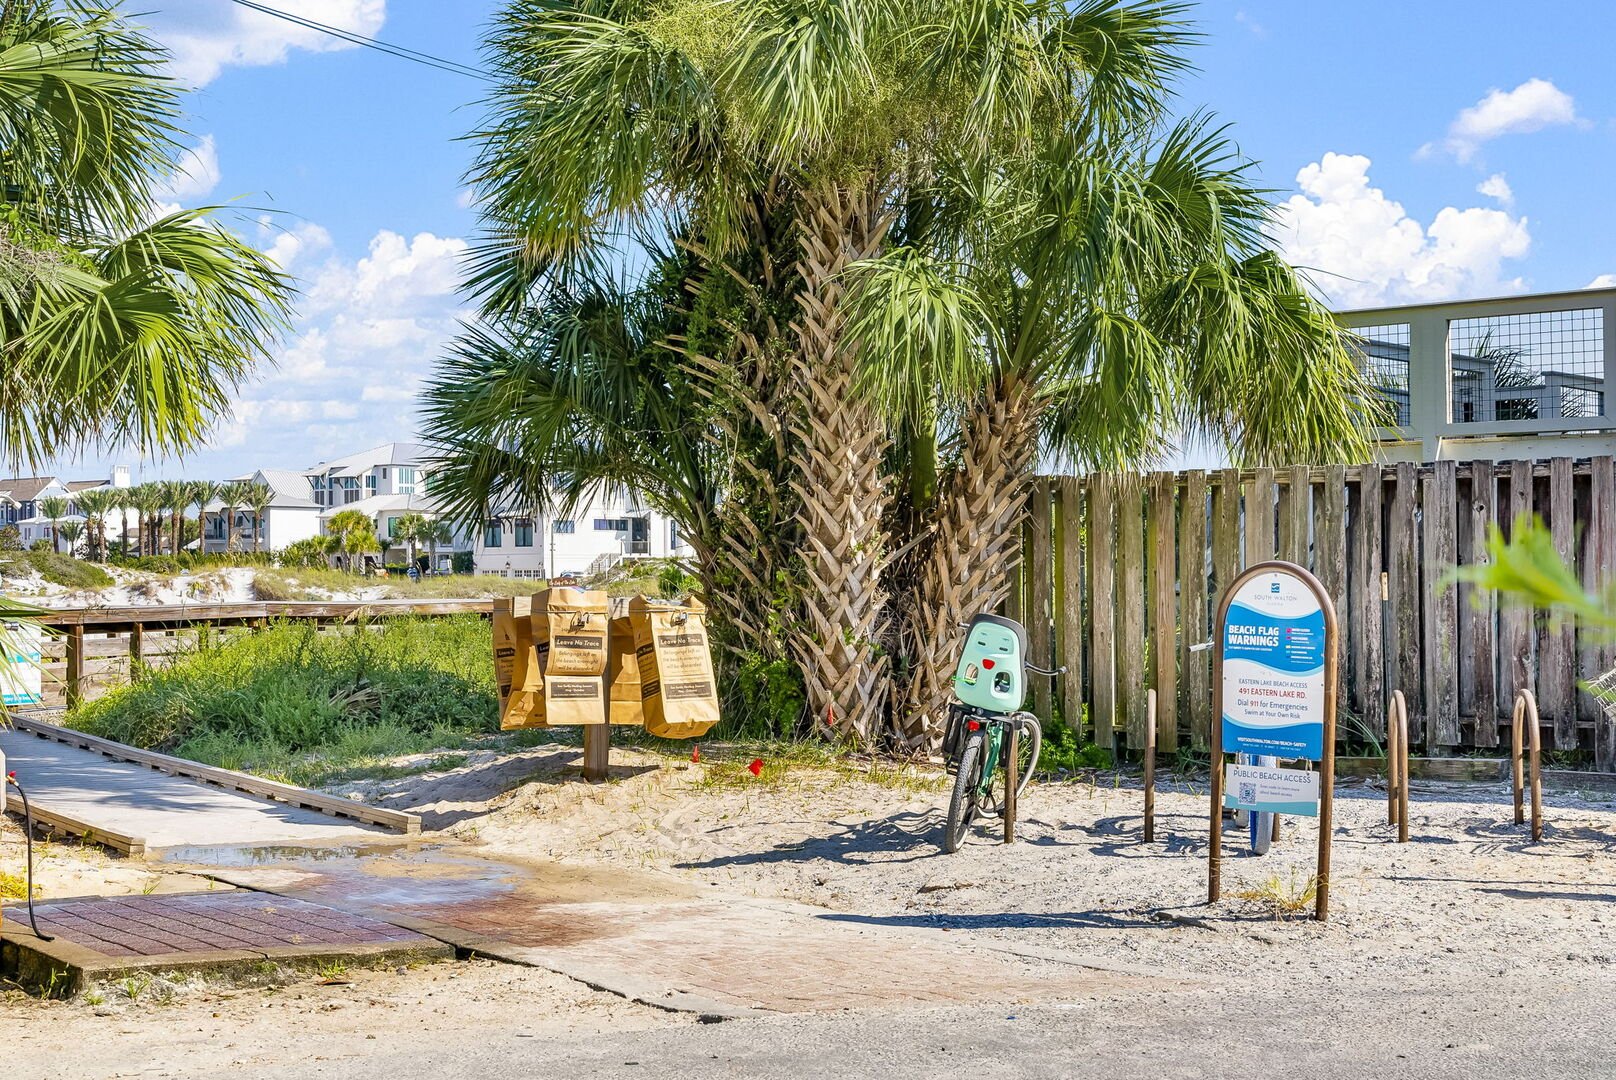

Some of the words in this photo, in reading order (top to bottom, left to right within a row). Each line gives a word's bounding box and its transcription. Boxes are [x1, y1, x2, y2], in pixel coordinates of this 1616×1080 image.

[1228, 625, 1256, 635] BEACH
[1258, 626, 1279, 636] FLAG
[1228, 635, 1279, 647] WARNINGS
[1239, 678, 1260, 686] EASTERN
[1251, 688, 1278, 697] EASTERN
[1279, 690, 1295, 698] LAKE
[1296, 691, 1307, 699] RD.
[1260, 700, 1268, 708] for
[1269, 702, 1308, 711] Emergencies
[1233, 769, 1258, 779] PUBLIC
[1259, 772, 1282, 781] BEACH
[1284, 775, 1311, 784] ACCESS
